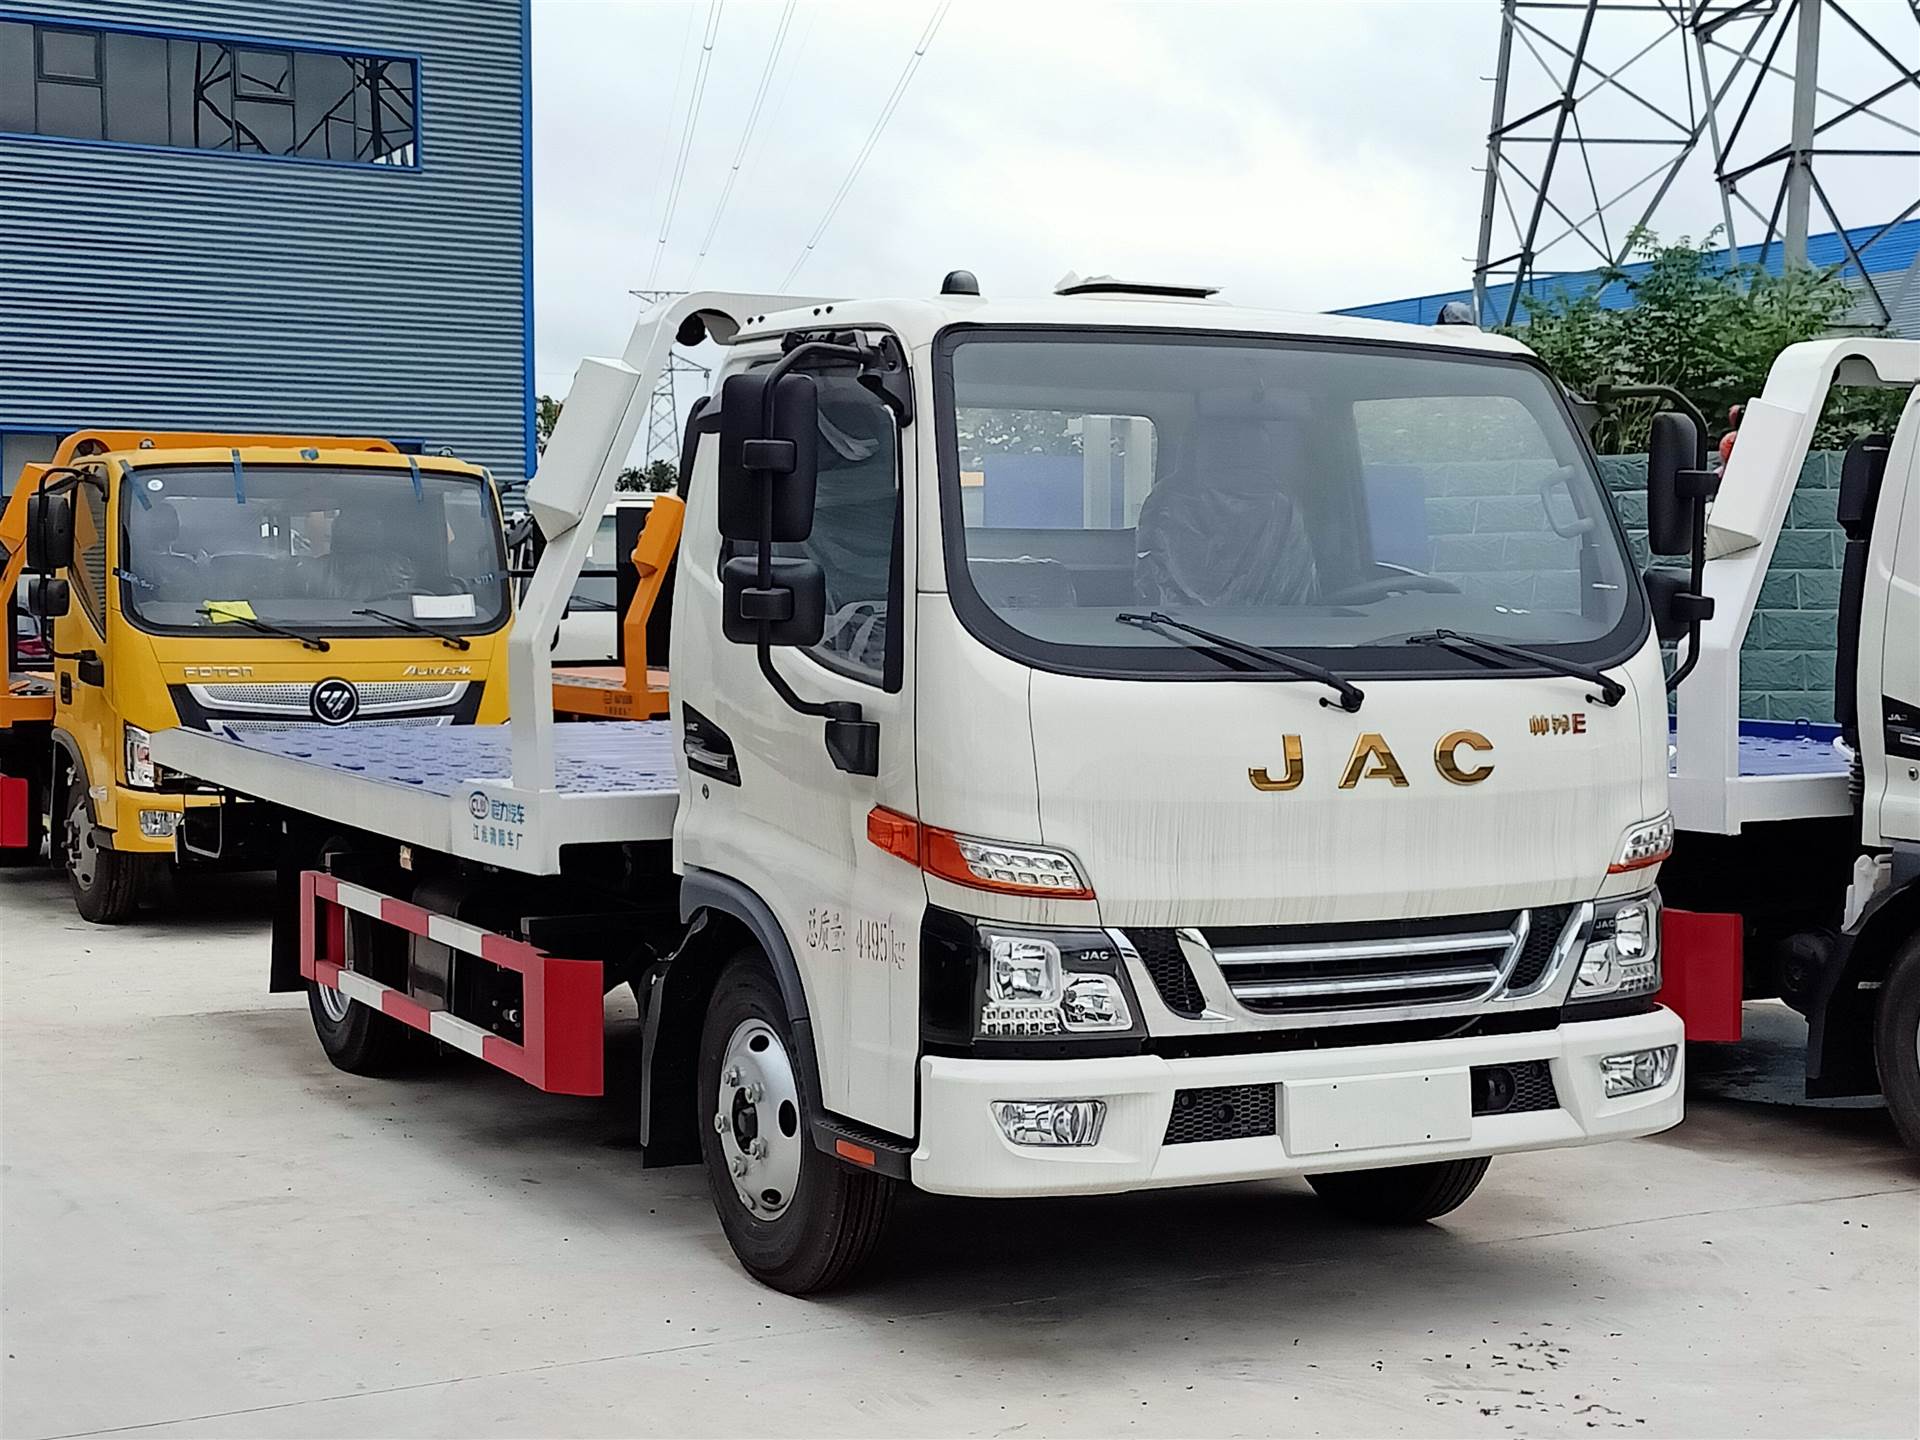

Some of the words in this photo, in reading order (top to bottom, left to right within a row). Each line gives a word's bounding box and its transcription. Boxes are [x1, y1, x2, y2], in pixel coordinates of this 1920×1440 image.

[184, 665, 254, 678] FOTON
[1248, 729, 1496, 792] JAC
[1595, 919, 1615, 929] JAC
[1080, 950, 1109, 960] JAC
